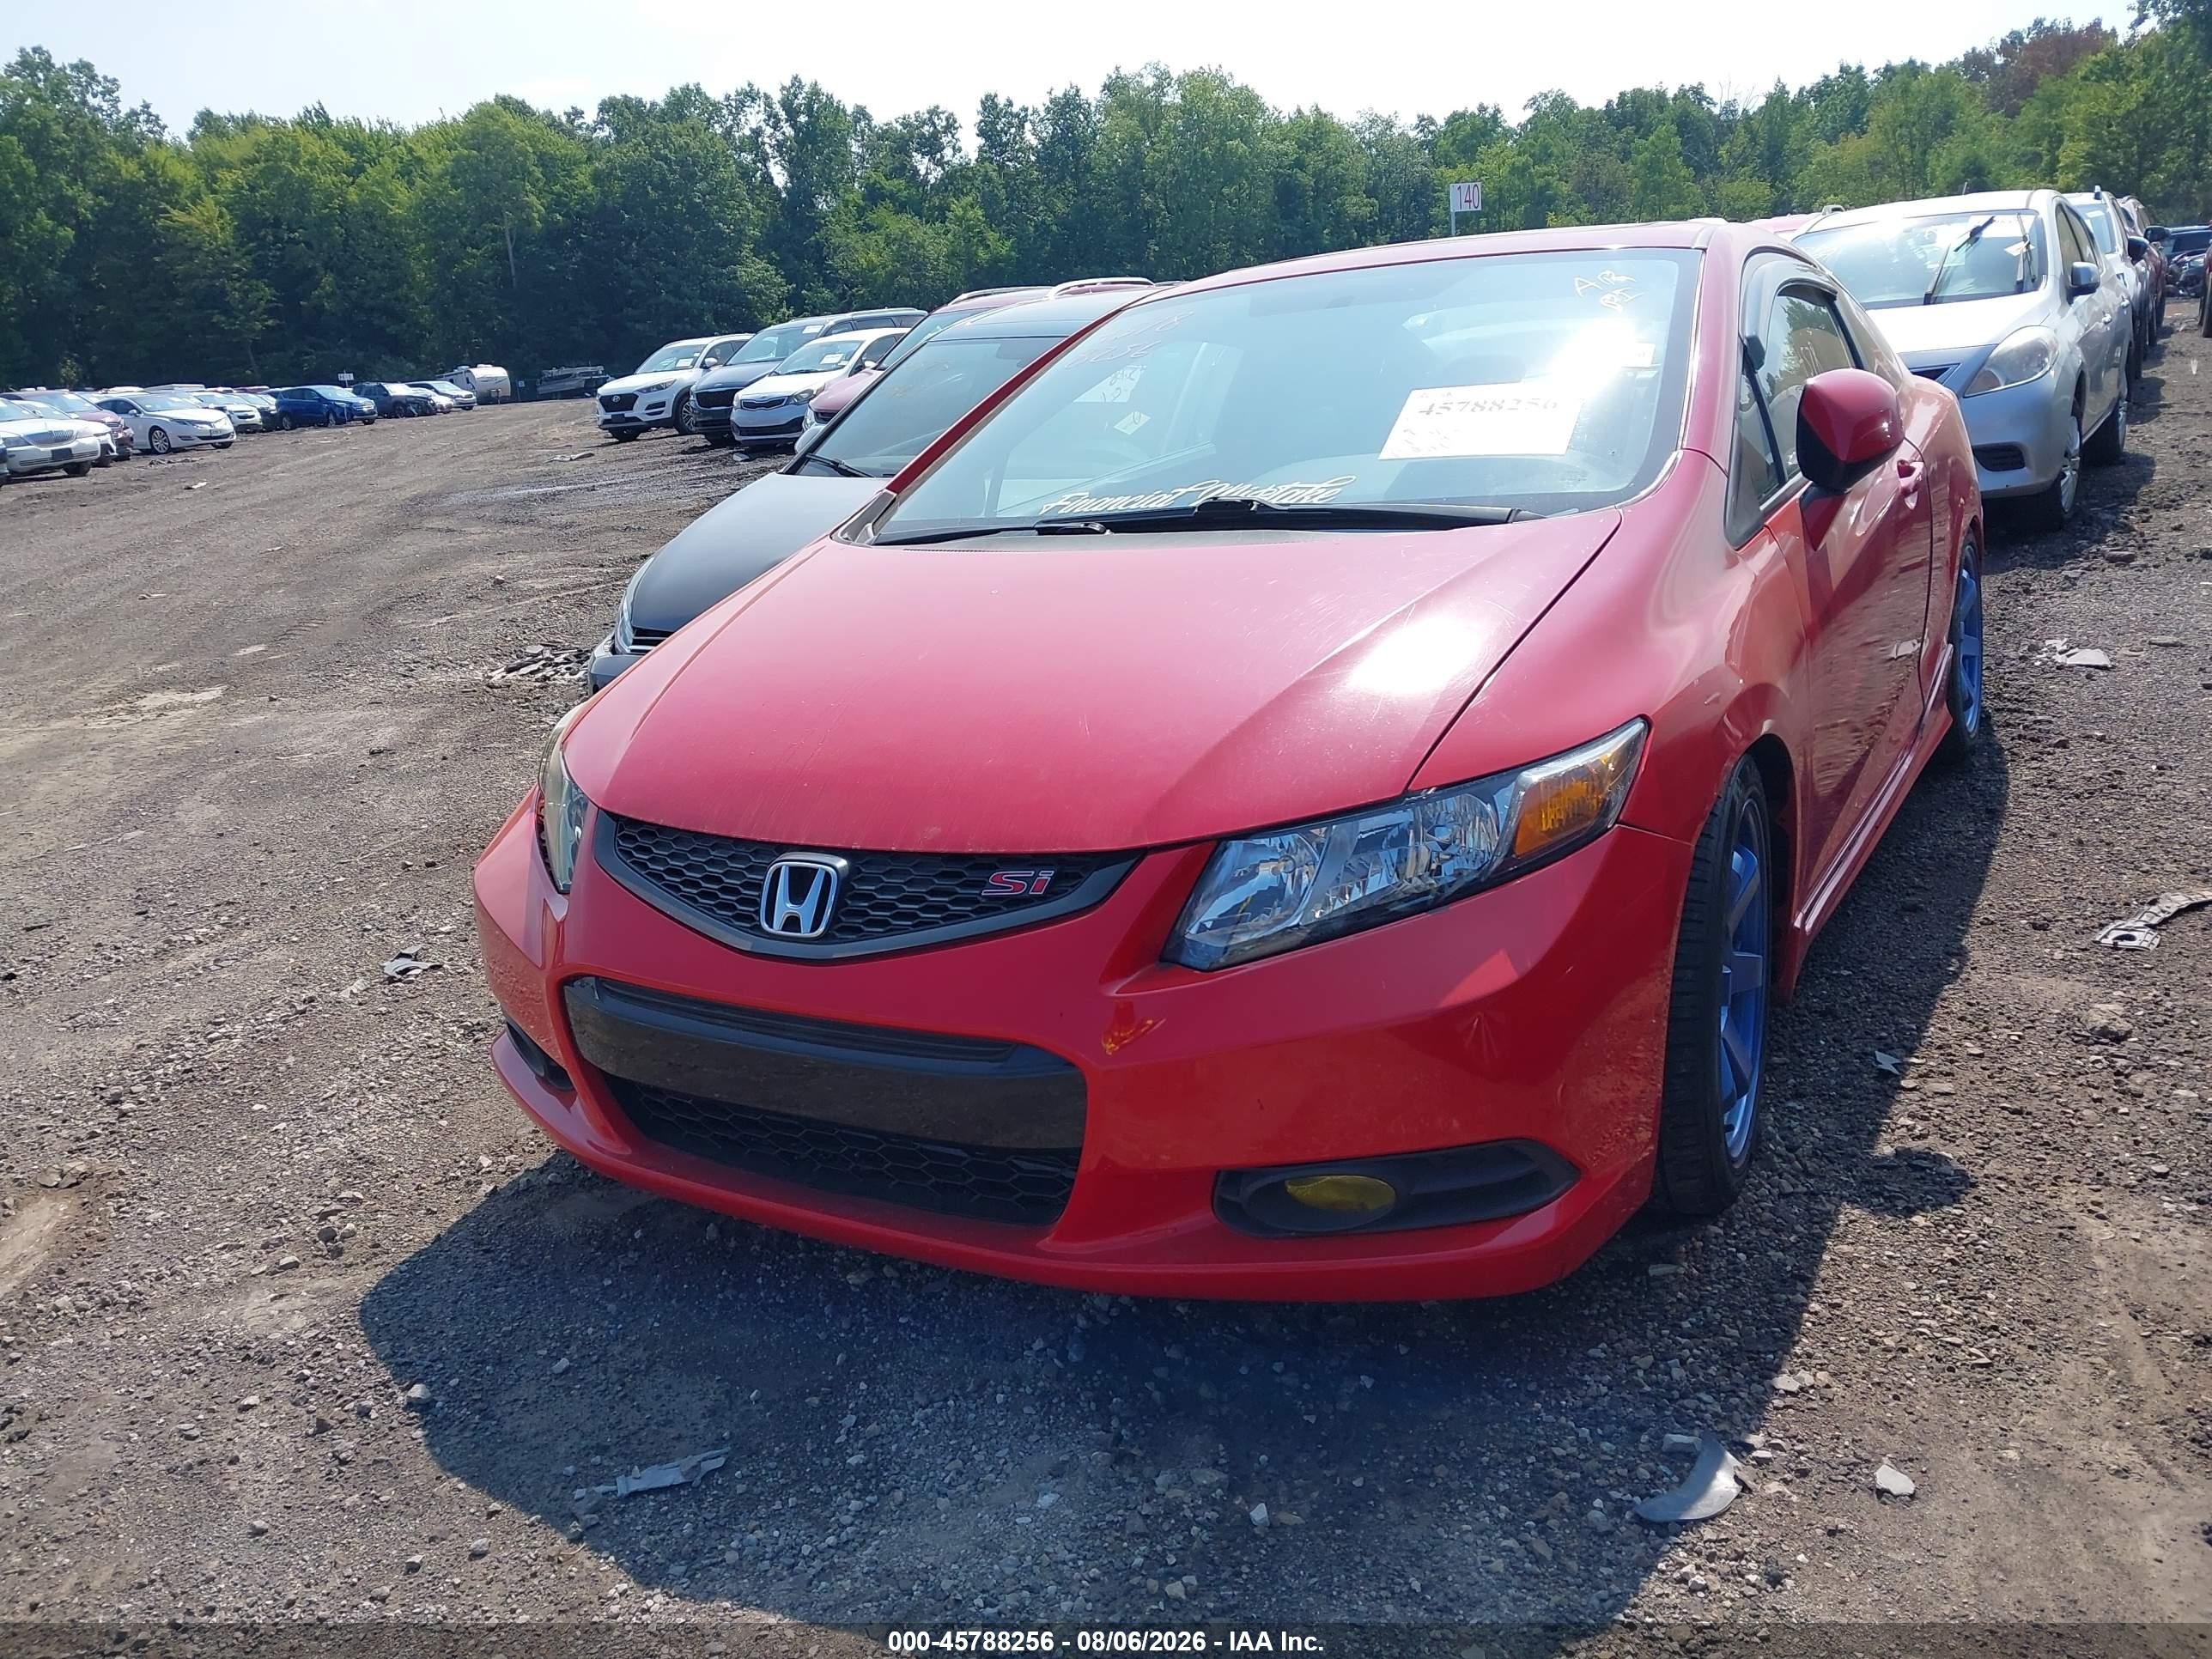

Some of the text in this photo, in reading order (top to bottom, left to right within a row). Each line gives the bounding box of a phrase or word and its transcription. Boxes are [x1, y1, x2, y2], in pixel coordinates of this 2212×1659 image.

[1457, 184, 1480, 210] 140
[1038, 475, 1358, 515] Financial Mistake
[981, 869, 1055, 896] Si
